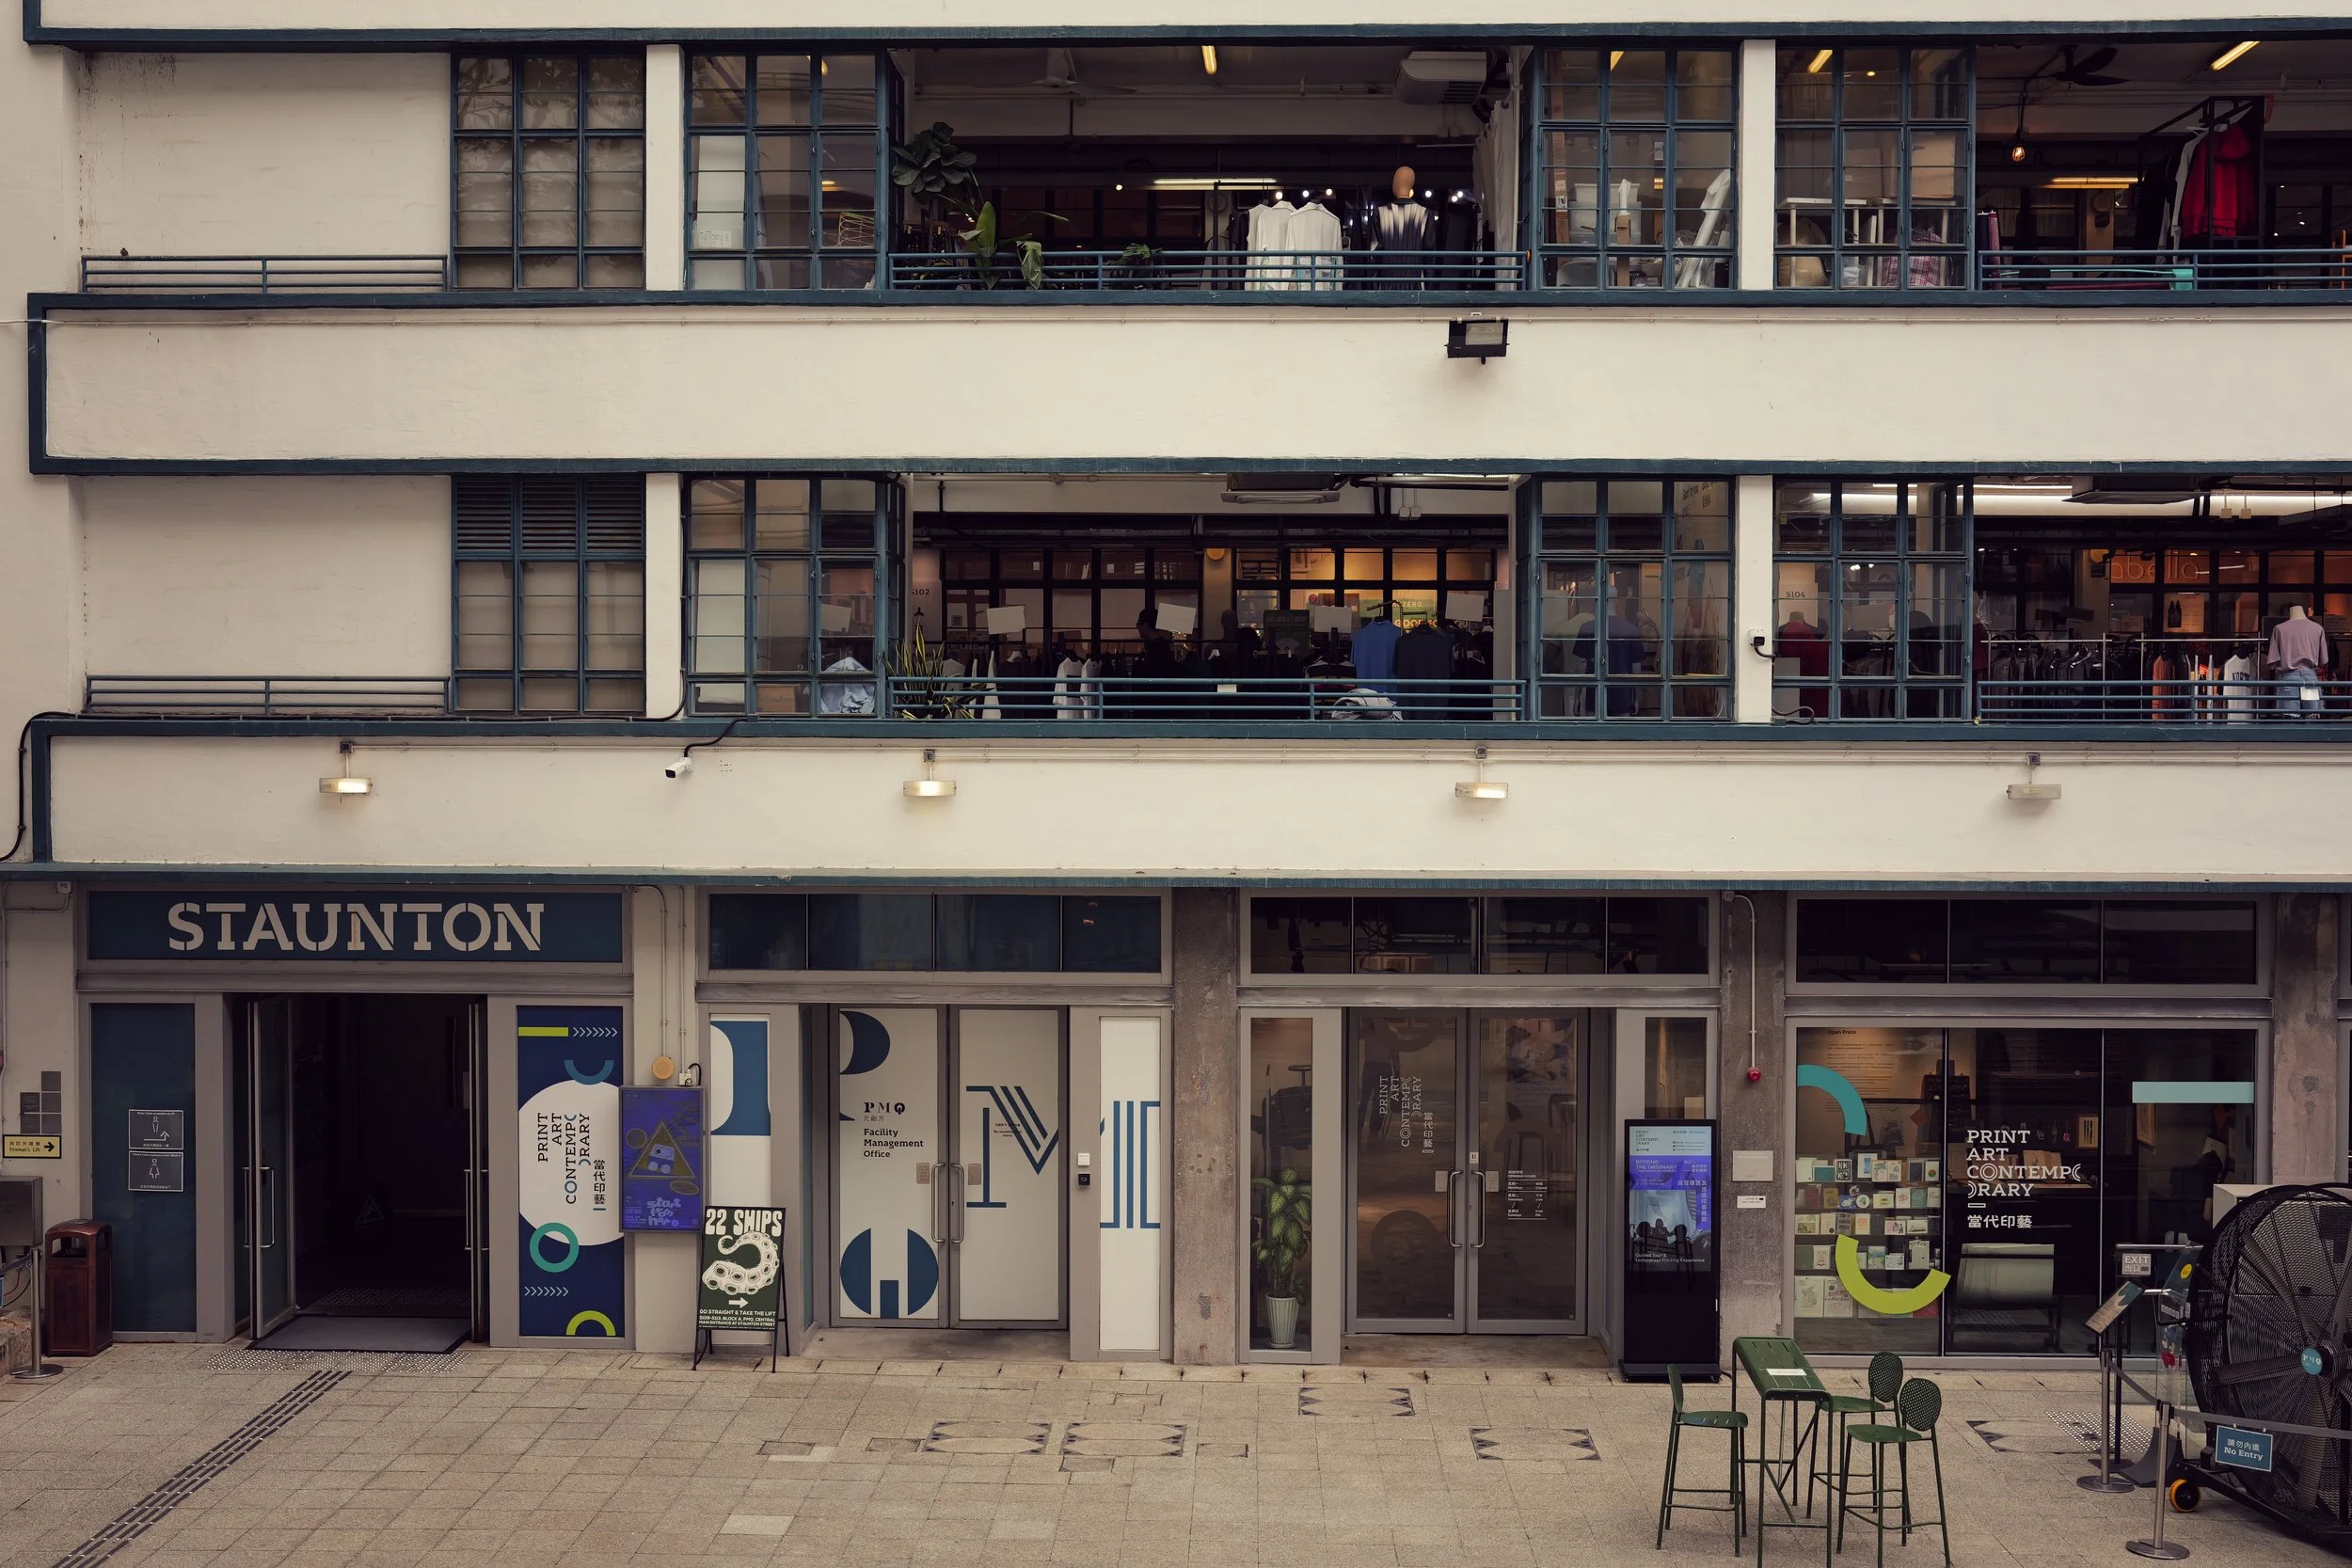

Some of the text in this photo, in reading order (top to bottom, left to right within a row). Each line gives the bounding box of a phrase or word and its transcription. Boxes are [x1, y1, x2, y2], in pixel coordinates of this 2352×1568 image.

[167, 902, 545, 952] STAUNTON
[1391, 1075, 1399, 1101] ART
[1379, 1075, 1389, 1115] PRINT
[864, 1102, 905, 1115] PMQ
[551, 1113, 562, 1146] ART
[864, 1129, 898, 1137] Facility
[537, 1113, 548, 1162] PRINT
[1967, 1130, 2030, 1143] PRINT
[864, 1139, 924, 1148] Management
[1966, 1148, 2009, 1161] ART
[594, 1160, 606, 1205] 當代印藝
[705, 1209, 783, 1237] 22 SHIPS
[1967, 1214, 2032, 1228] 當代印藝
[2125, 1256, 2150, 1264] EXIT
[2124, 1264, 2140, 1273] 出口
[2302, 1354, 2322, 1365] PMQ
[2227, 1438, 2260, 1451] 請勿內進
[2238, 1449, 2264, 1461] Entry
